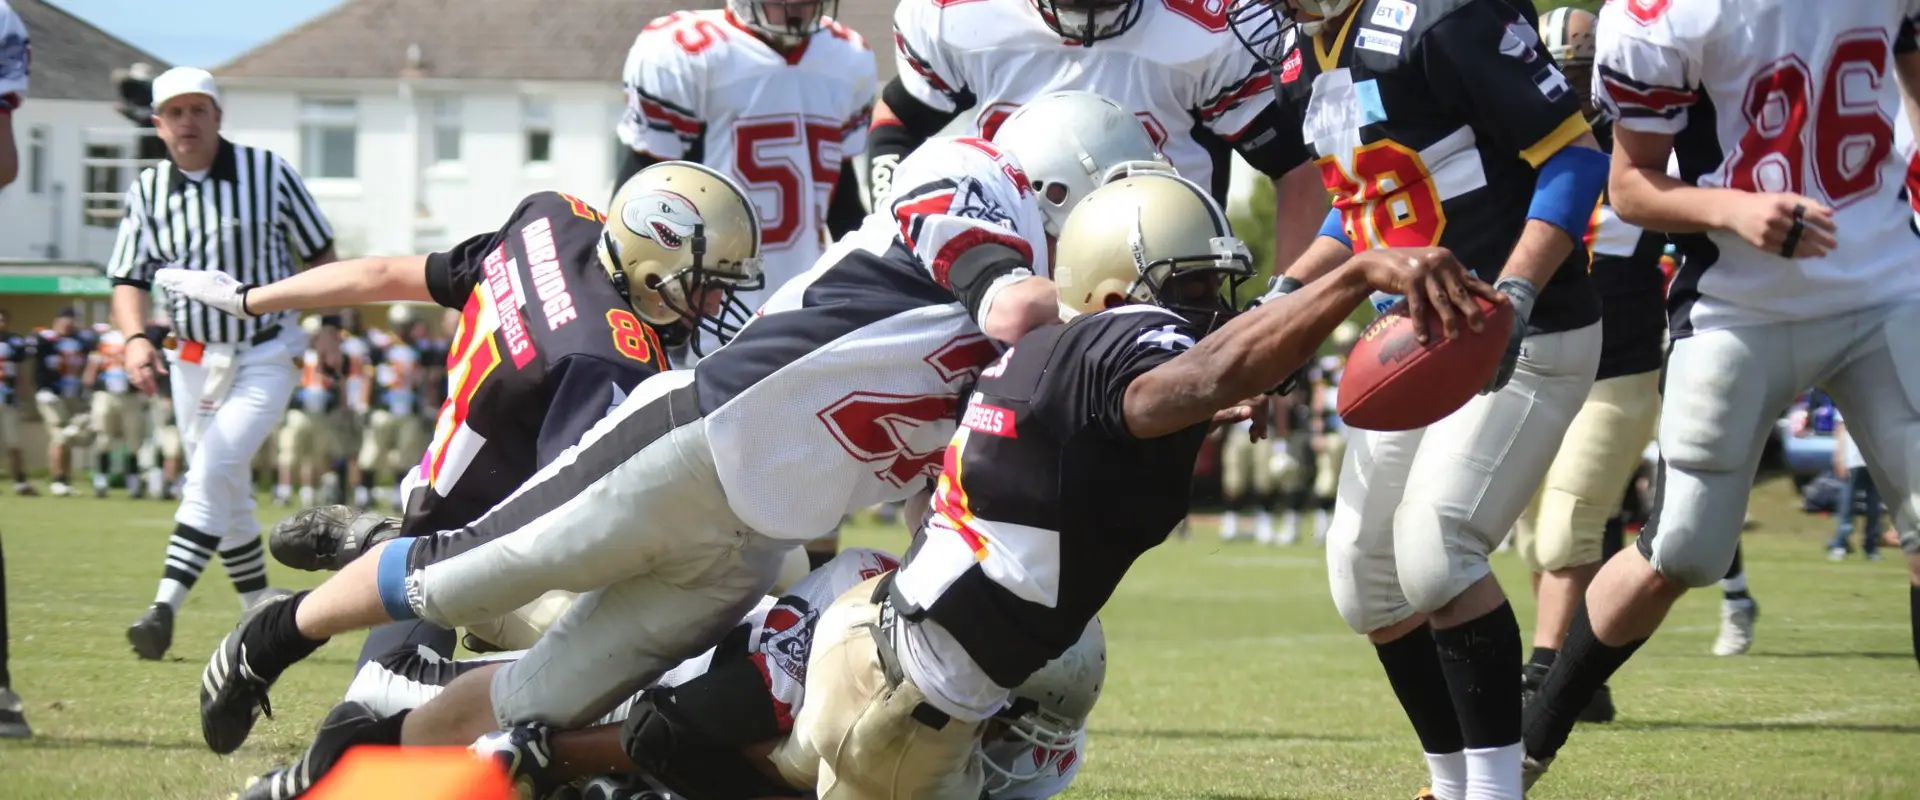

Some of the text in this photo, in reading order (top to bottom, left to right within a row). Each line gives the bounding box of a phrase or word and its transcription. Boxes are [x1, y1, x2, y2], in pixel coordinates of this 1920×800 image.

[1376, 6, 1394, 18] BT
[1723, 27, 1894, 210] 86
[497, 292, 530, 356] DIESELS
